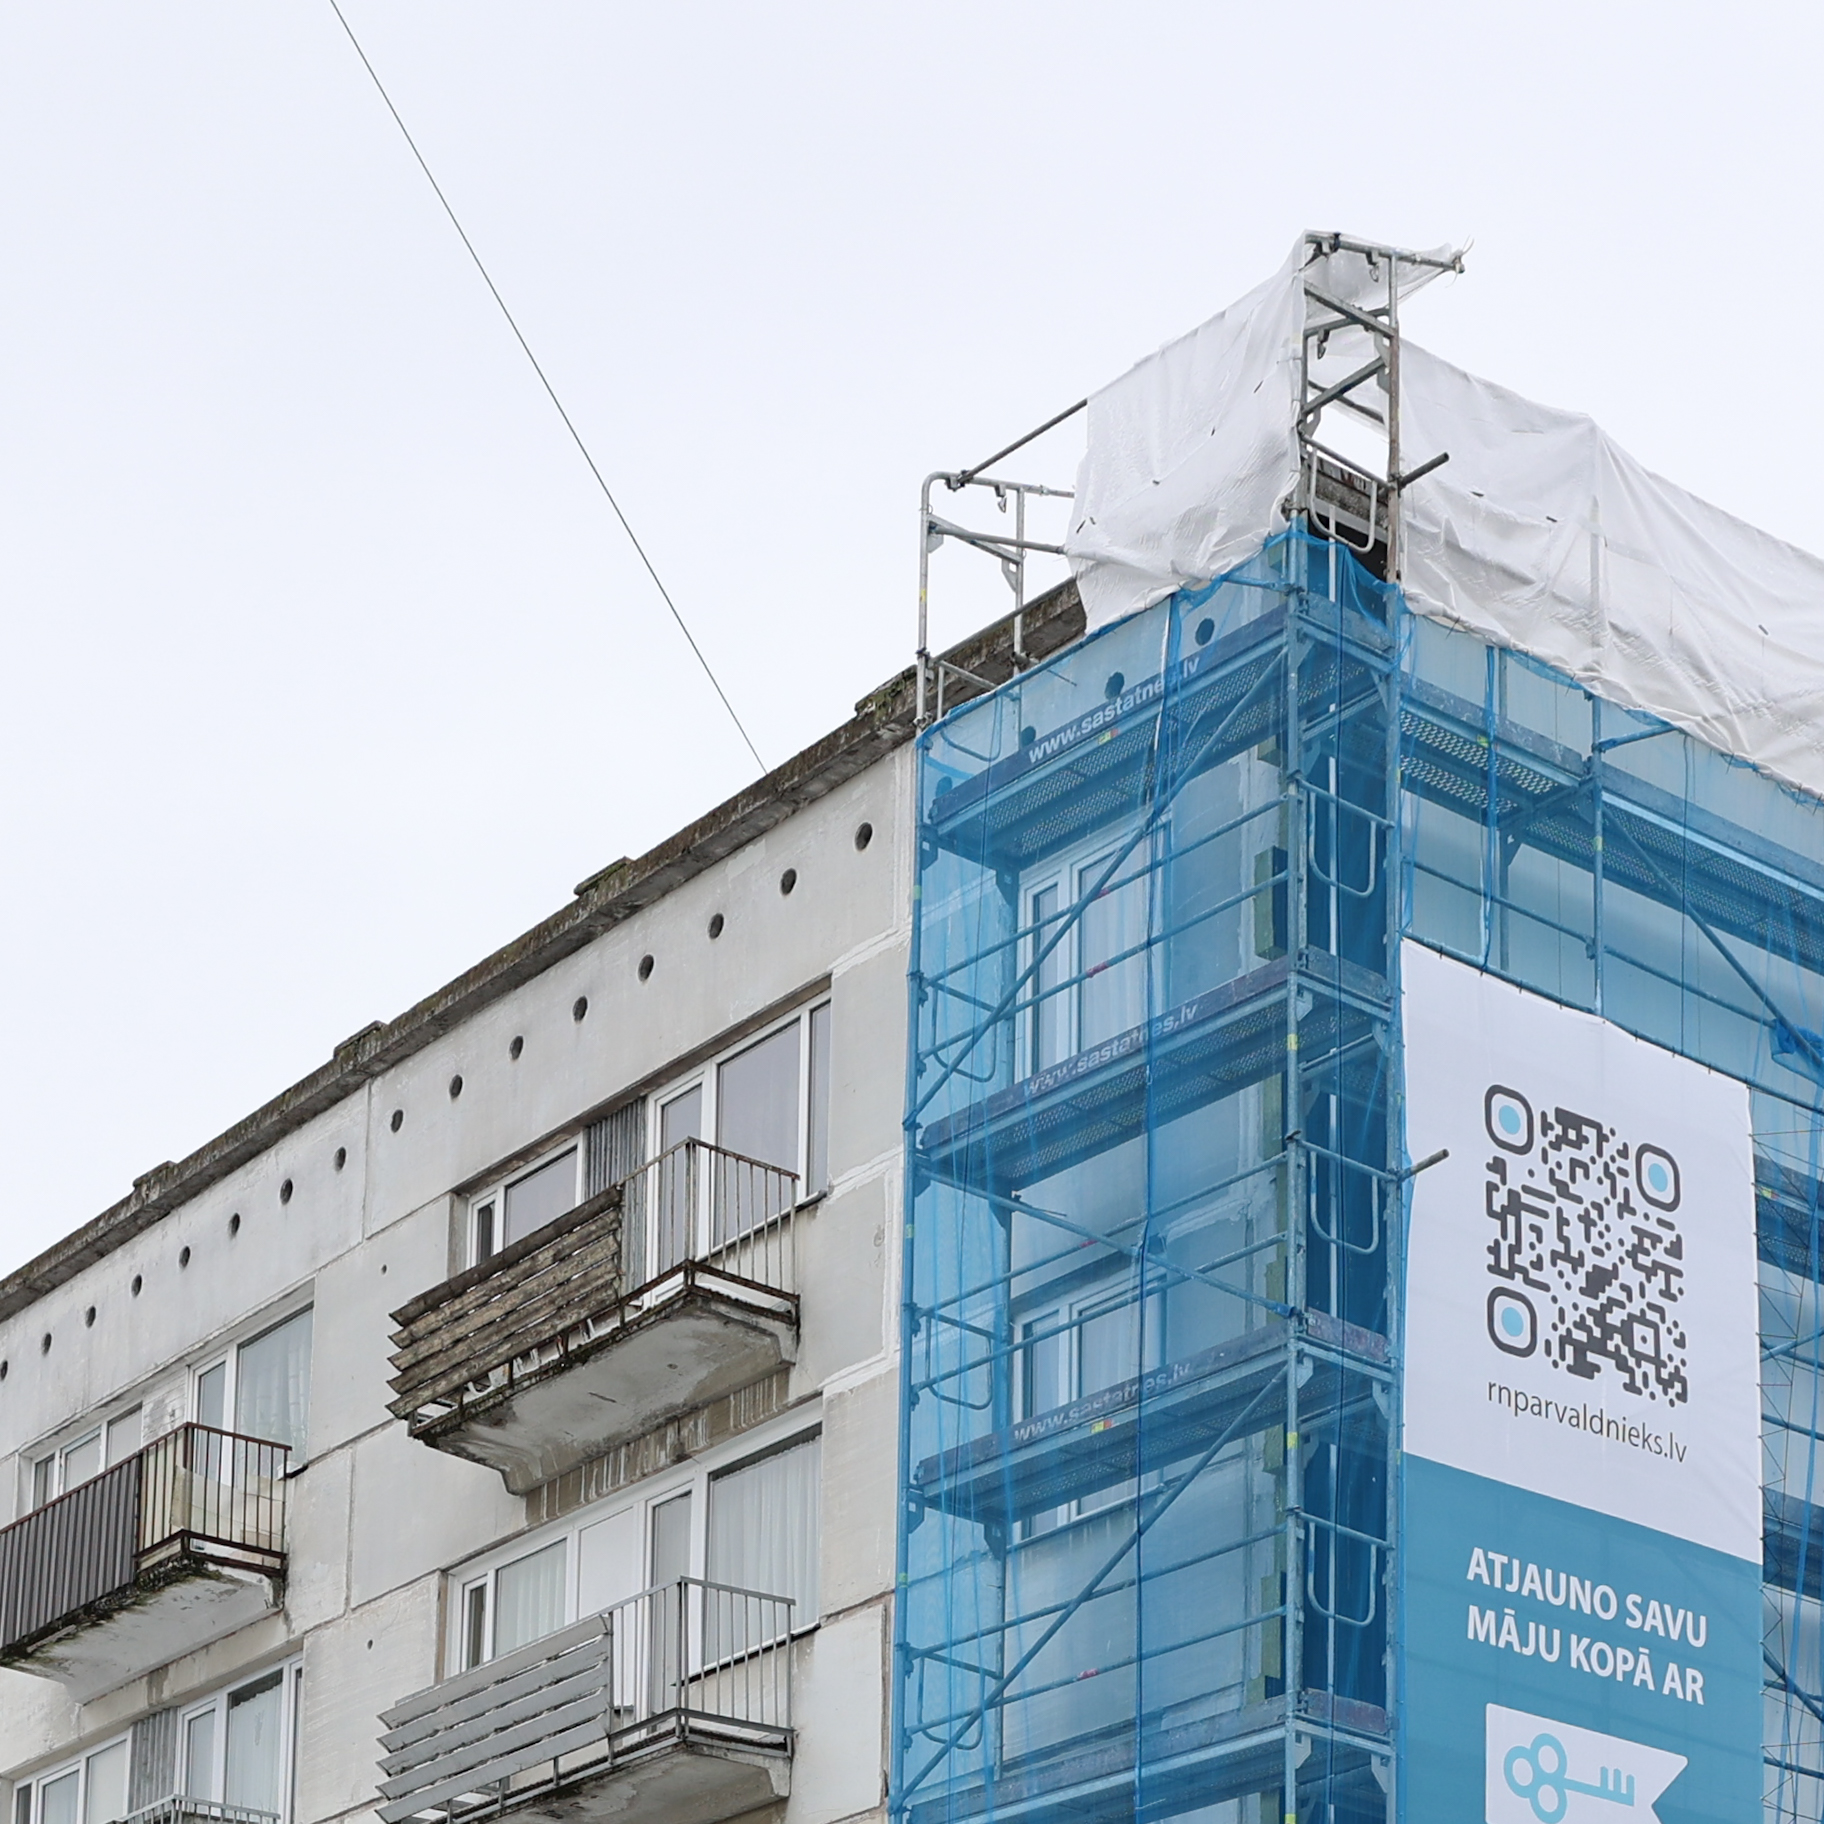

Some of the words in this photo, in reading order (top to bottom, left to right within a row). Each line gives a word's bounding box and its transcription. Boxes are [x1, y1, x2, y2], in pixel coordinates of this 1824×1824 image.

[1488, 1379, 1688, 1464] rnparvaldnieks.lv
[1466, 1546, 1617, 1621] ATJAUNO
[1626, 1593, 1707, 1648] SAVU
[1467, 1605, 1560, 1662] MĀJU
[1570, 1634, 1654, 1690] KOPĀ
[1663, 1668, 1704, 1705] AR
